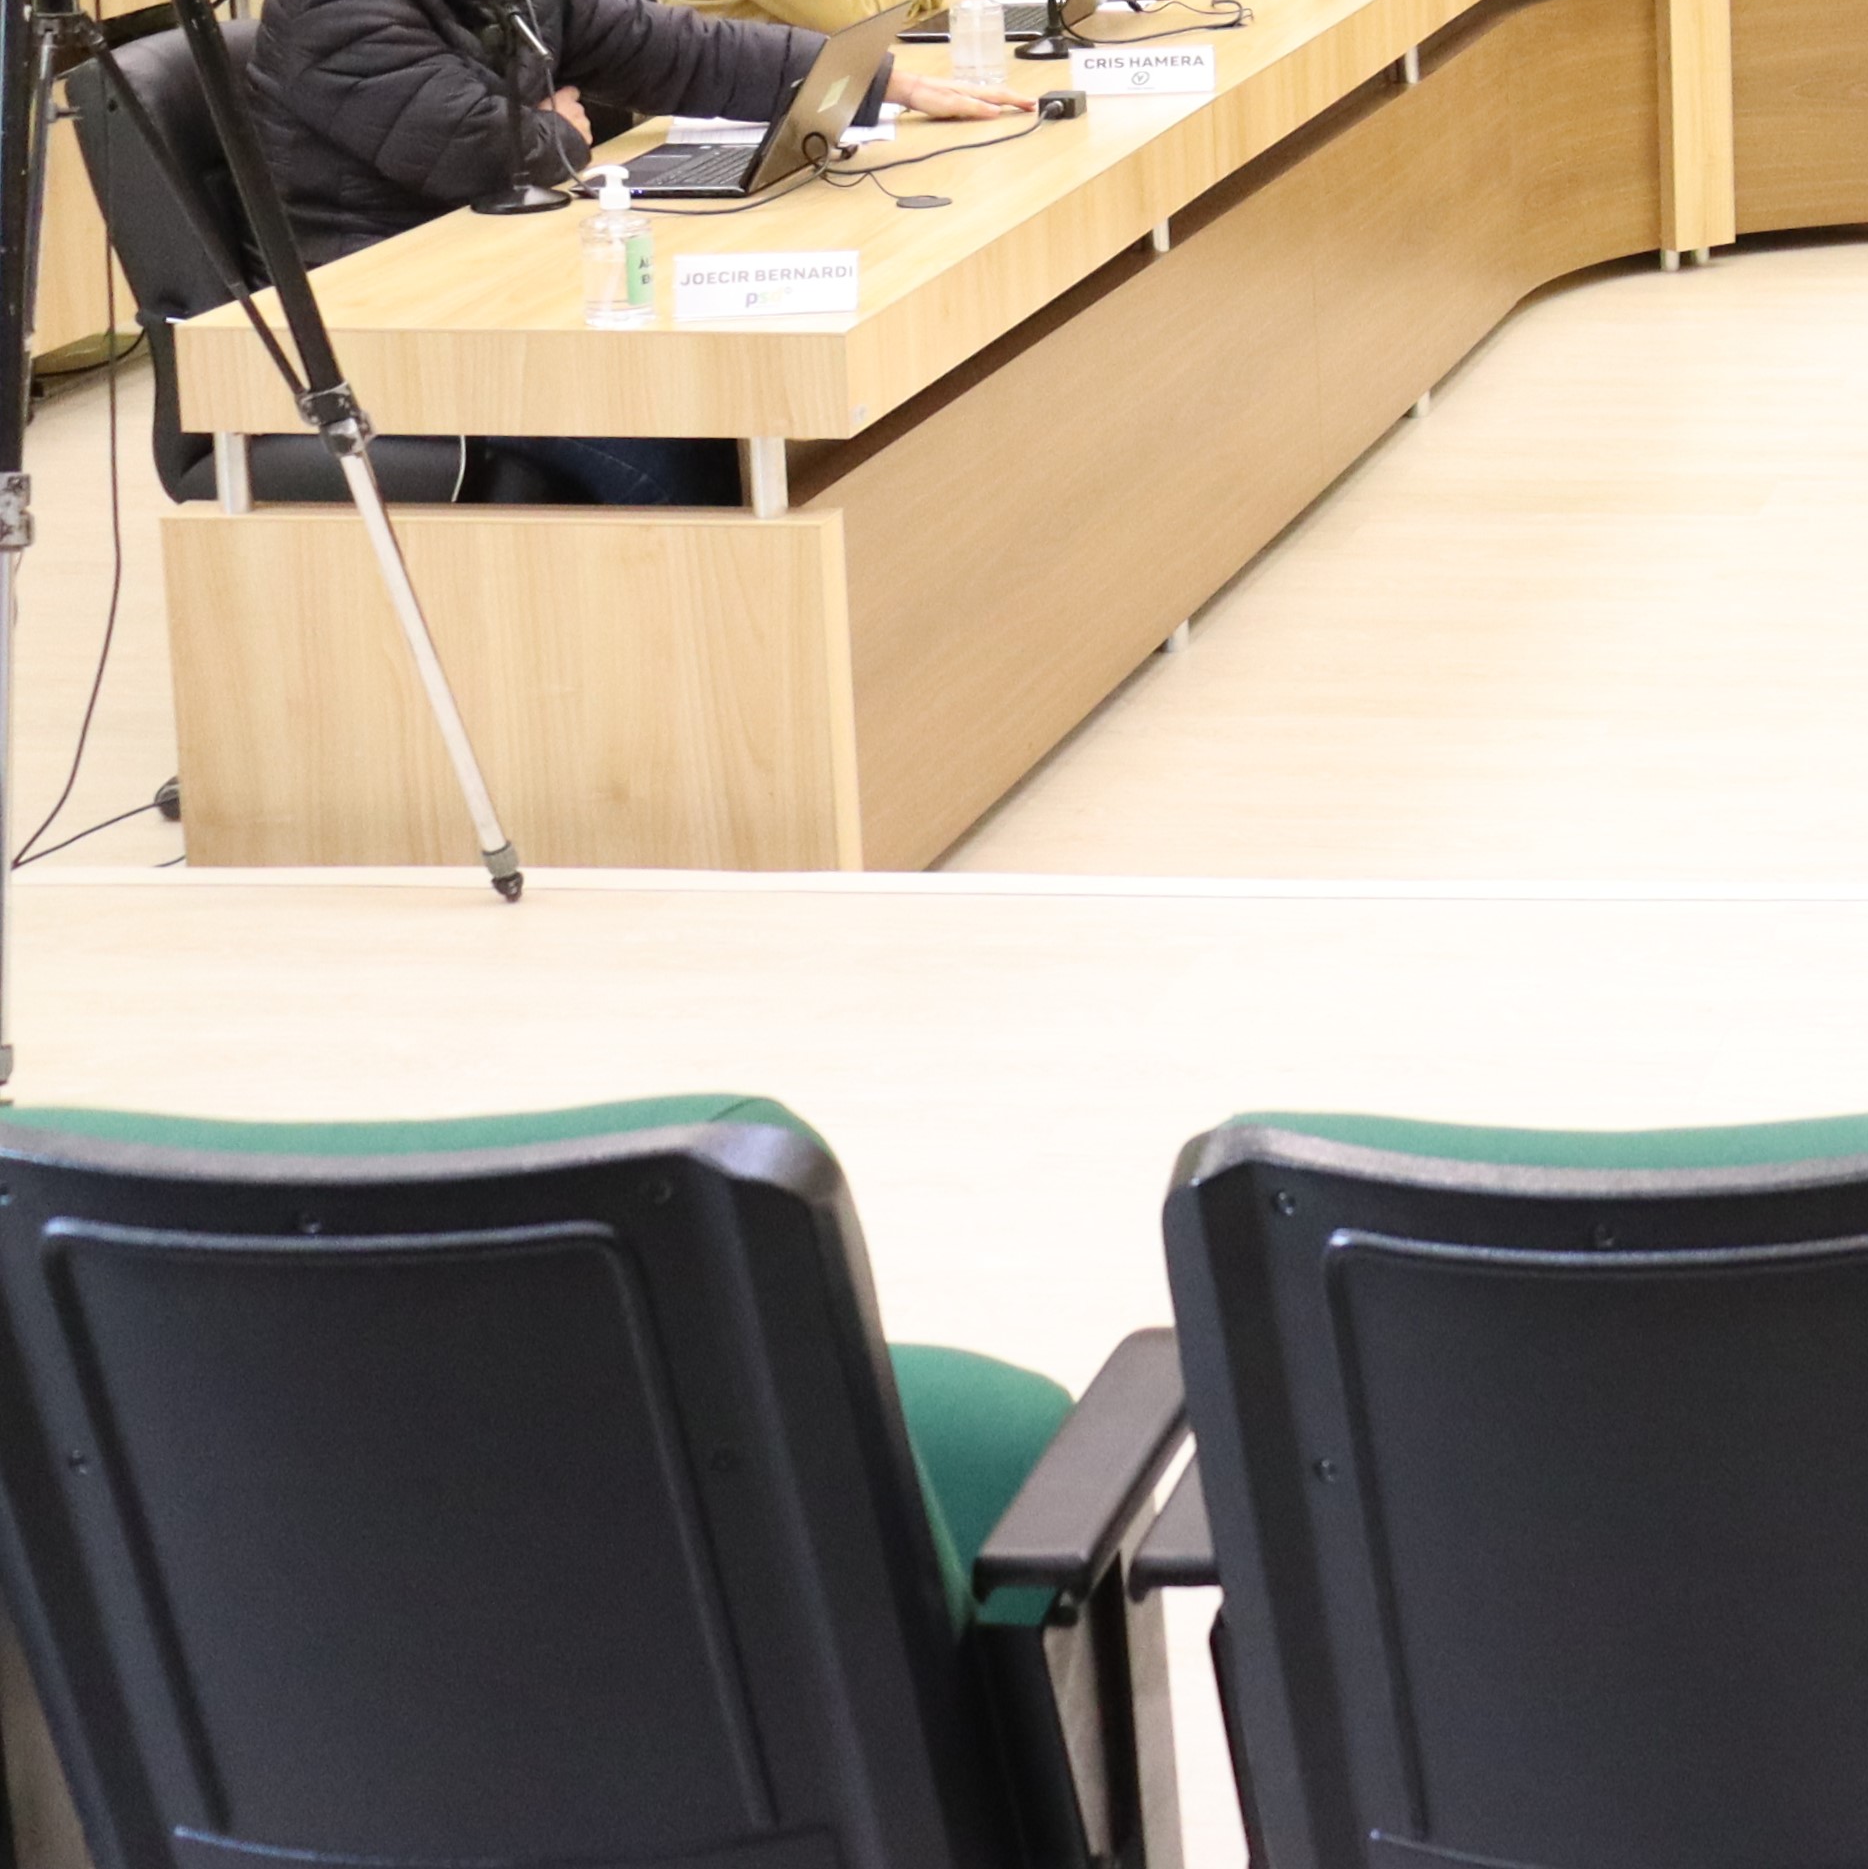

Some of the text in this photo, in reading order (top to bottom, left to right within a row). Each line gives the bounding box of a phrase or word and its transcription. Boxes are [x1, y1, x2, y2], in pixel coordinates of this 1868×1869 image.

[1084, 55, 1205, 69] CRIS HAMERA
[680, 265, 853, 286] JOECIR BERNARDI
